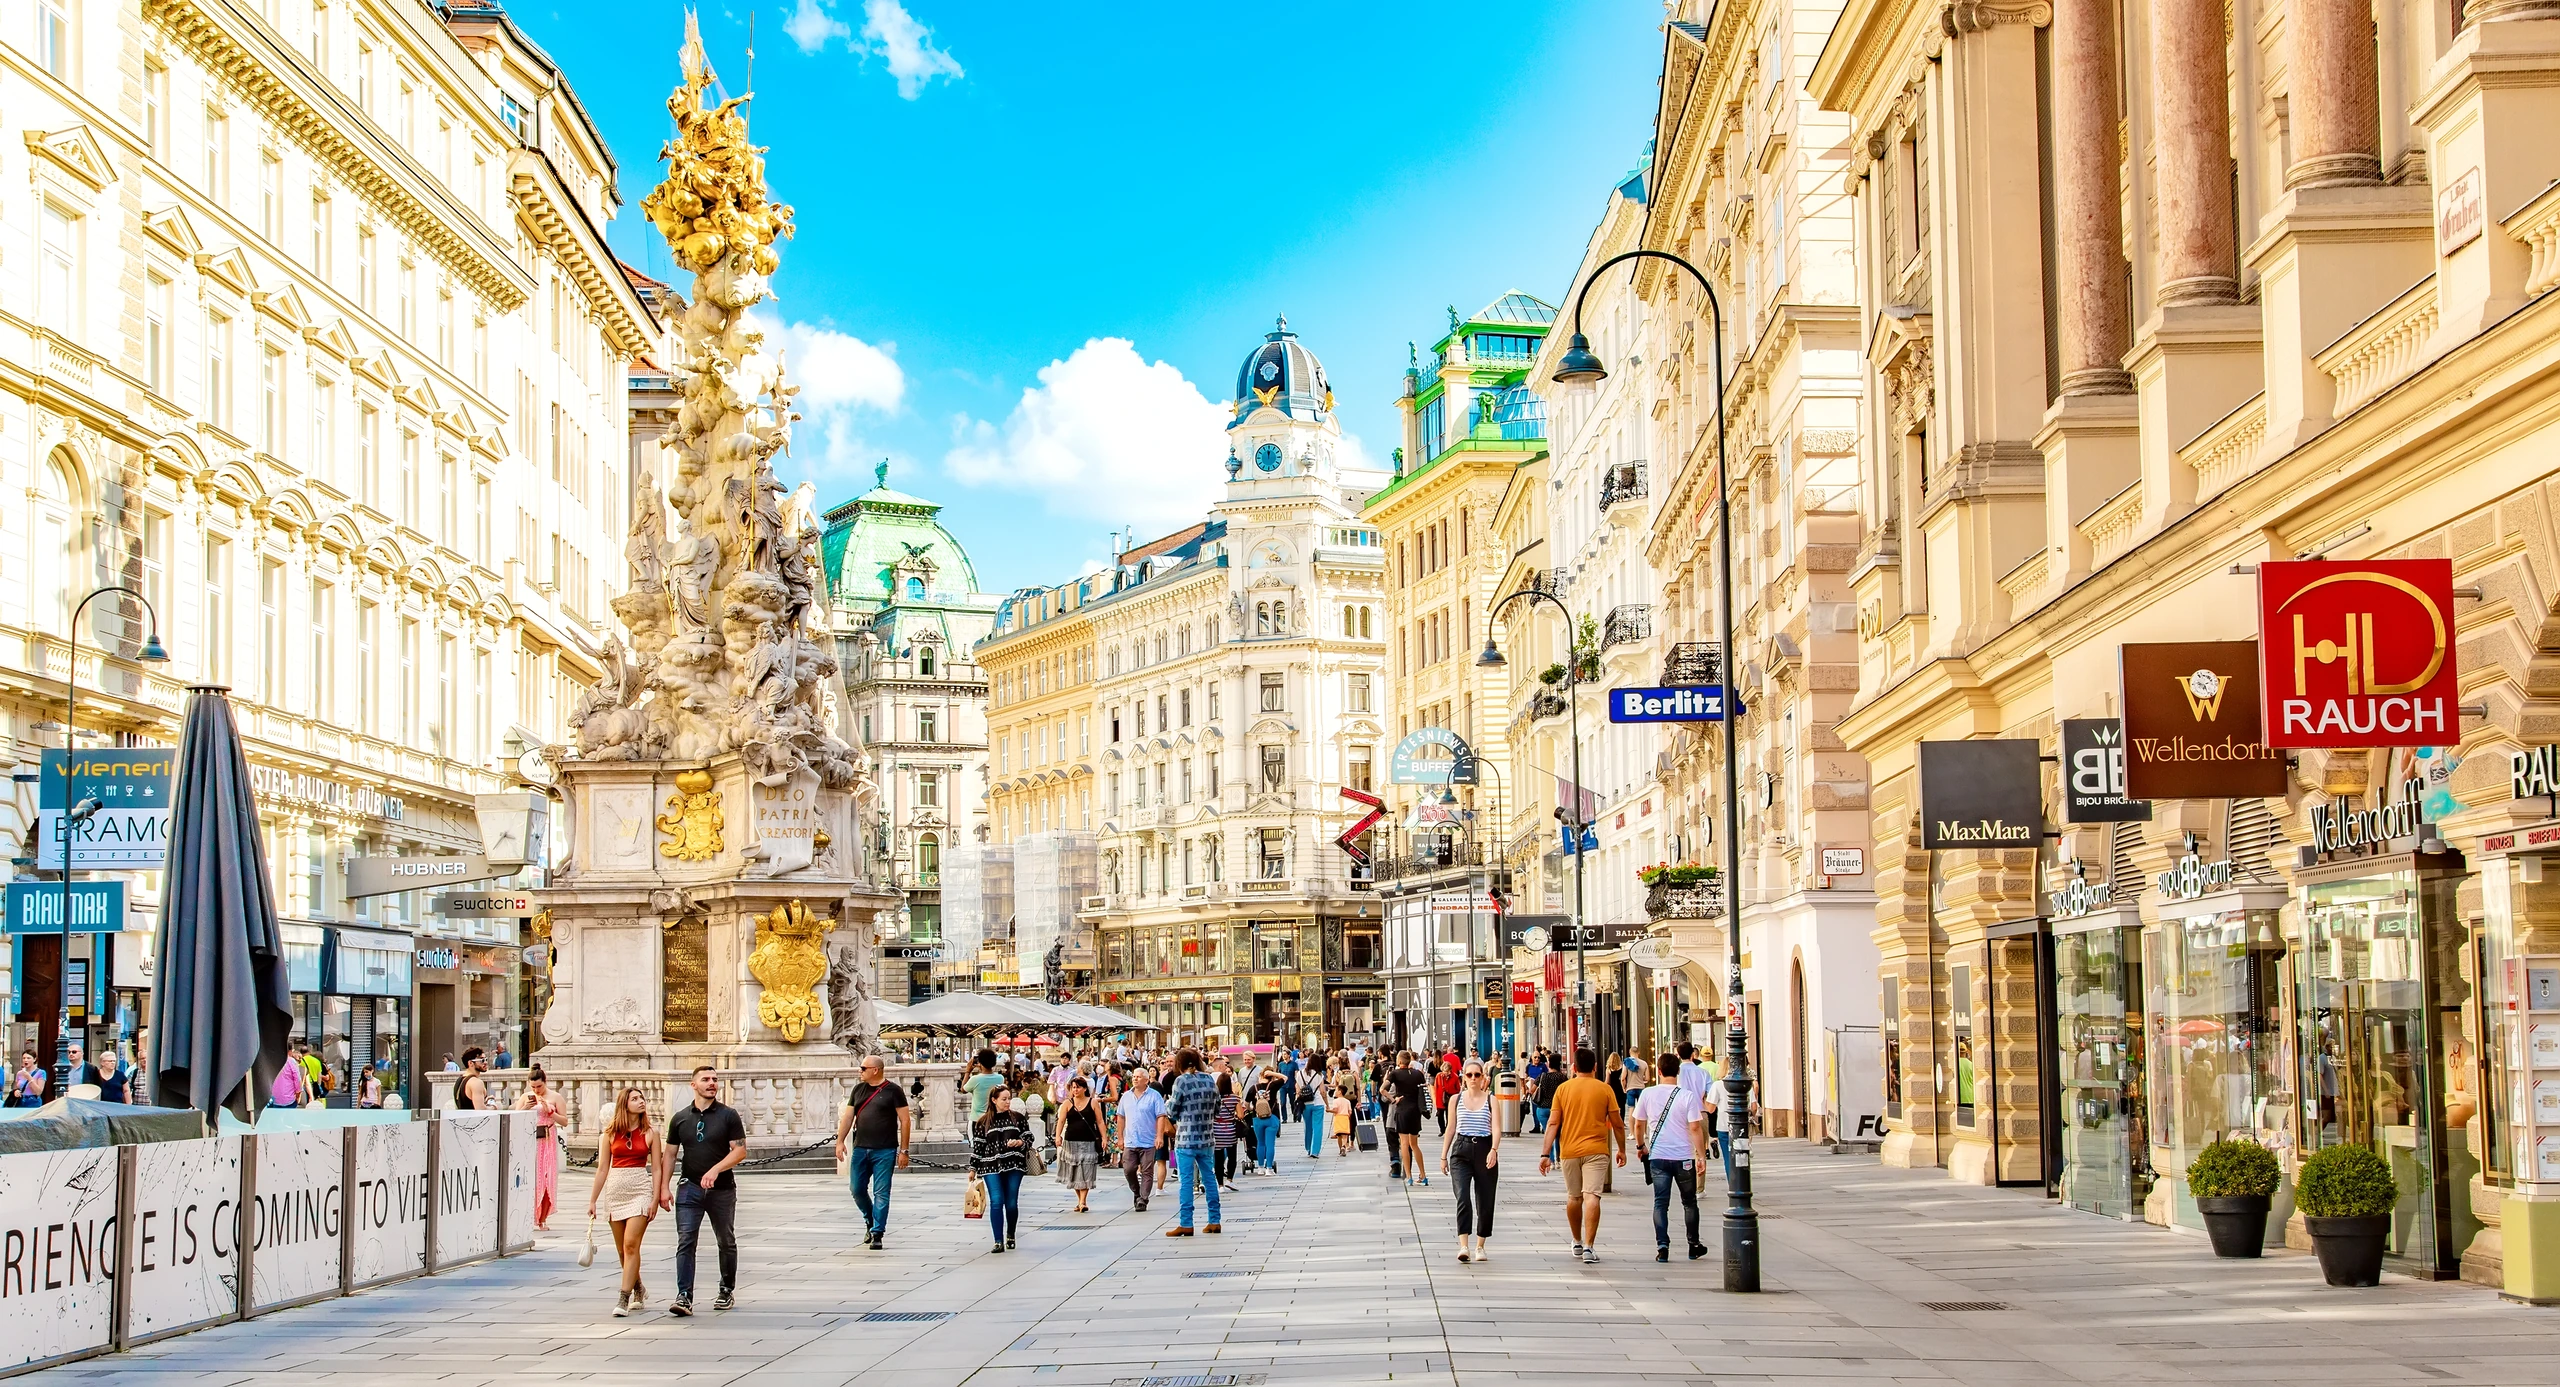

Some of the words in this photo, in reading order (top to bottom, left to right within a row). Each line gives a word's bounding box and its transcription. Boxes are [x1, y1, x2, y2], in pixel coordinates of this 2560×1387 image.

[1624, 690, 1721, 715] Berlitz
[2283, 697, 2445, 735] RAUCH
[56, 760, 175, 777] wieneri
[2510, 744, 2560, 800] RAU
[298, 773, 353, 807] RUDOLF
[357, 784, 404, 820] HÜBNER
[765, 786, 804, 801] DEO
[2076, 797, 2102, 807] BIJOU
[760, 808, 808, 820] PATRI
[2308, 777, 2424, 854] Wellendorff
[760, 827, 812, 838] CREATORI
[1937, 819, 2031, 841] MaxMara
[2528, 828, 2560, 845] BRIEFMA
[391, 862, 467, 876] HÜBNER
[453, 897, 515, 910] swatch
[416, 947, 453, 969] swatch
[1514, 985, 1533, 993] högl
[3, 1210, 157, 1299] RIENCE
[172, 1204, 198, 1267] IS
[212, 1184, 339, 1259] COMING
[359, 1177, 389, 1231] TO
[397, 1165, 481, 1224] VIENNA
